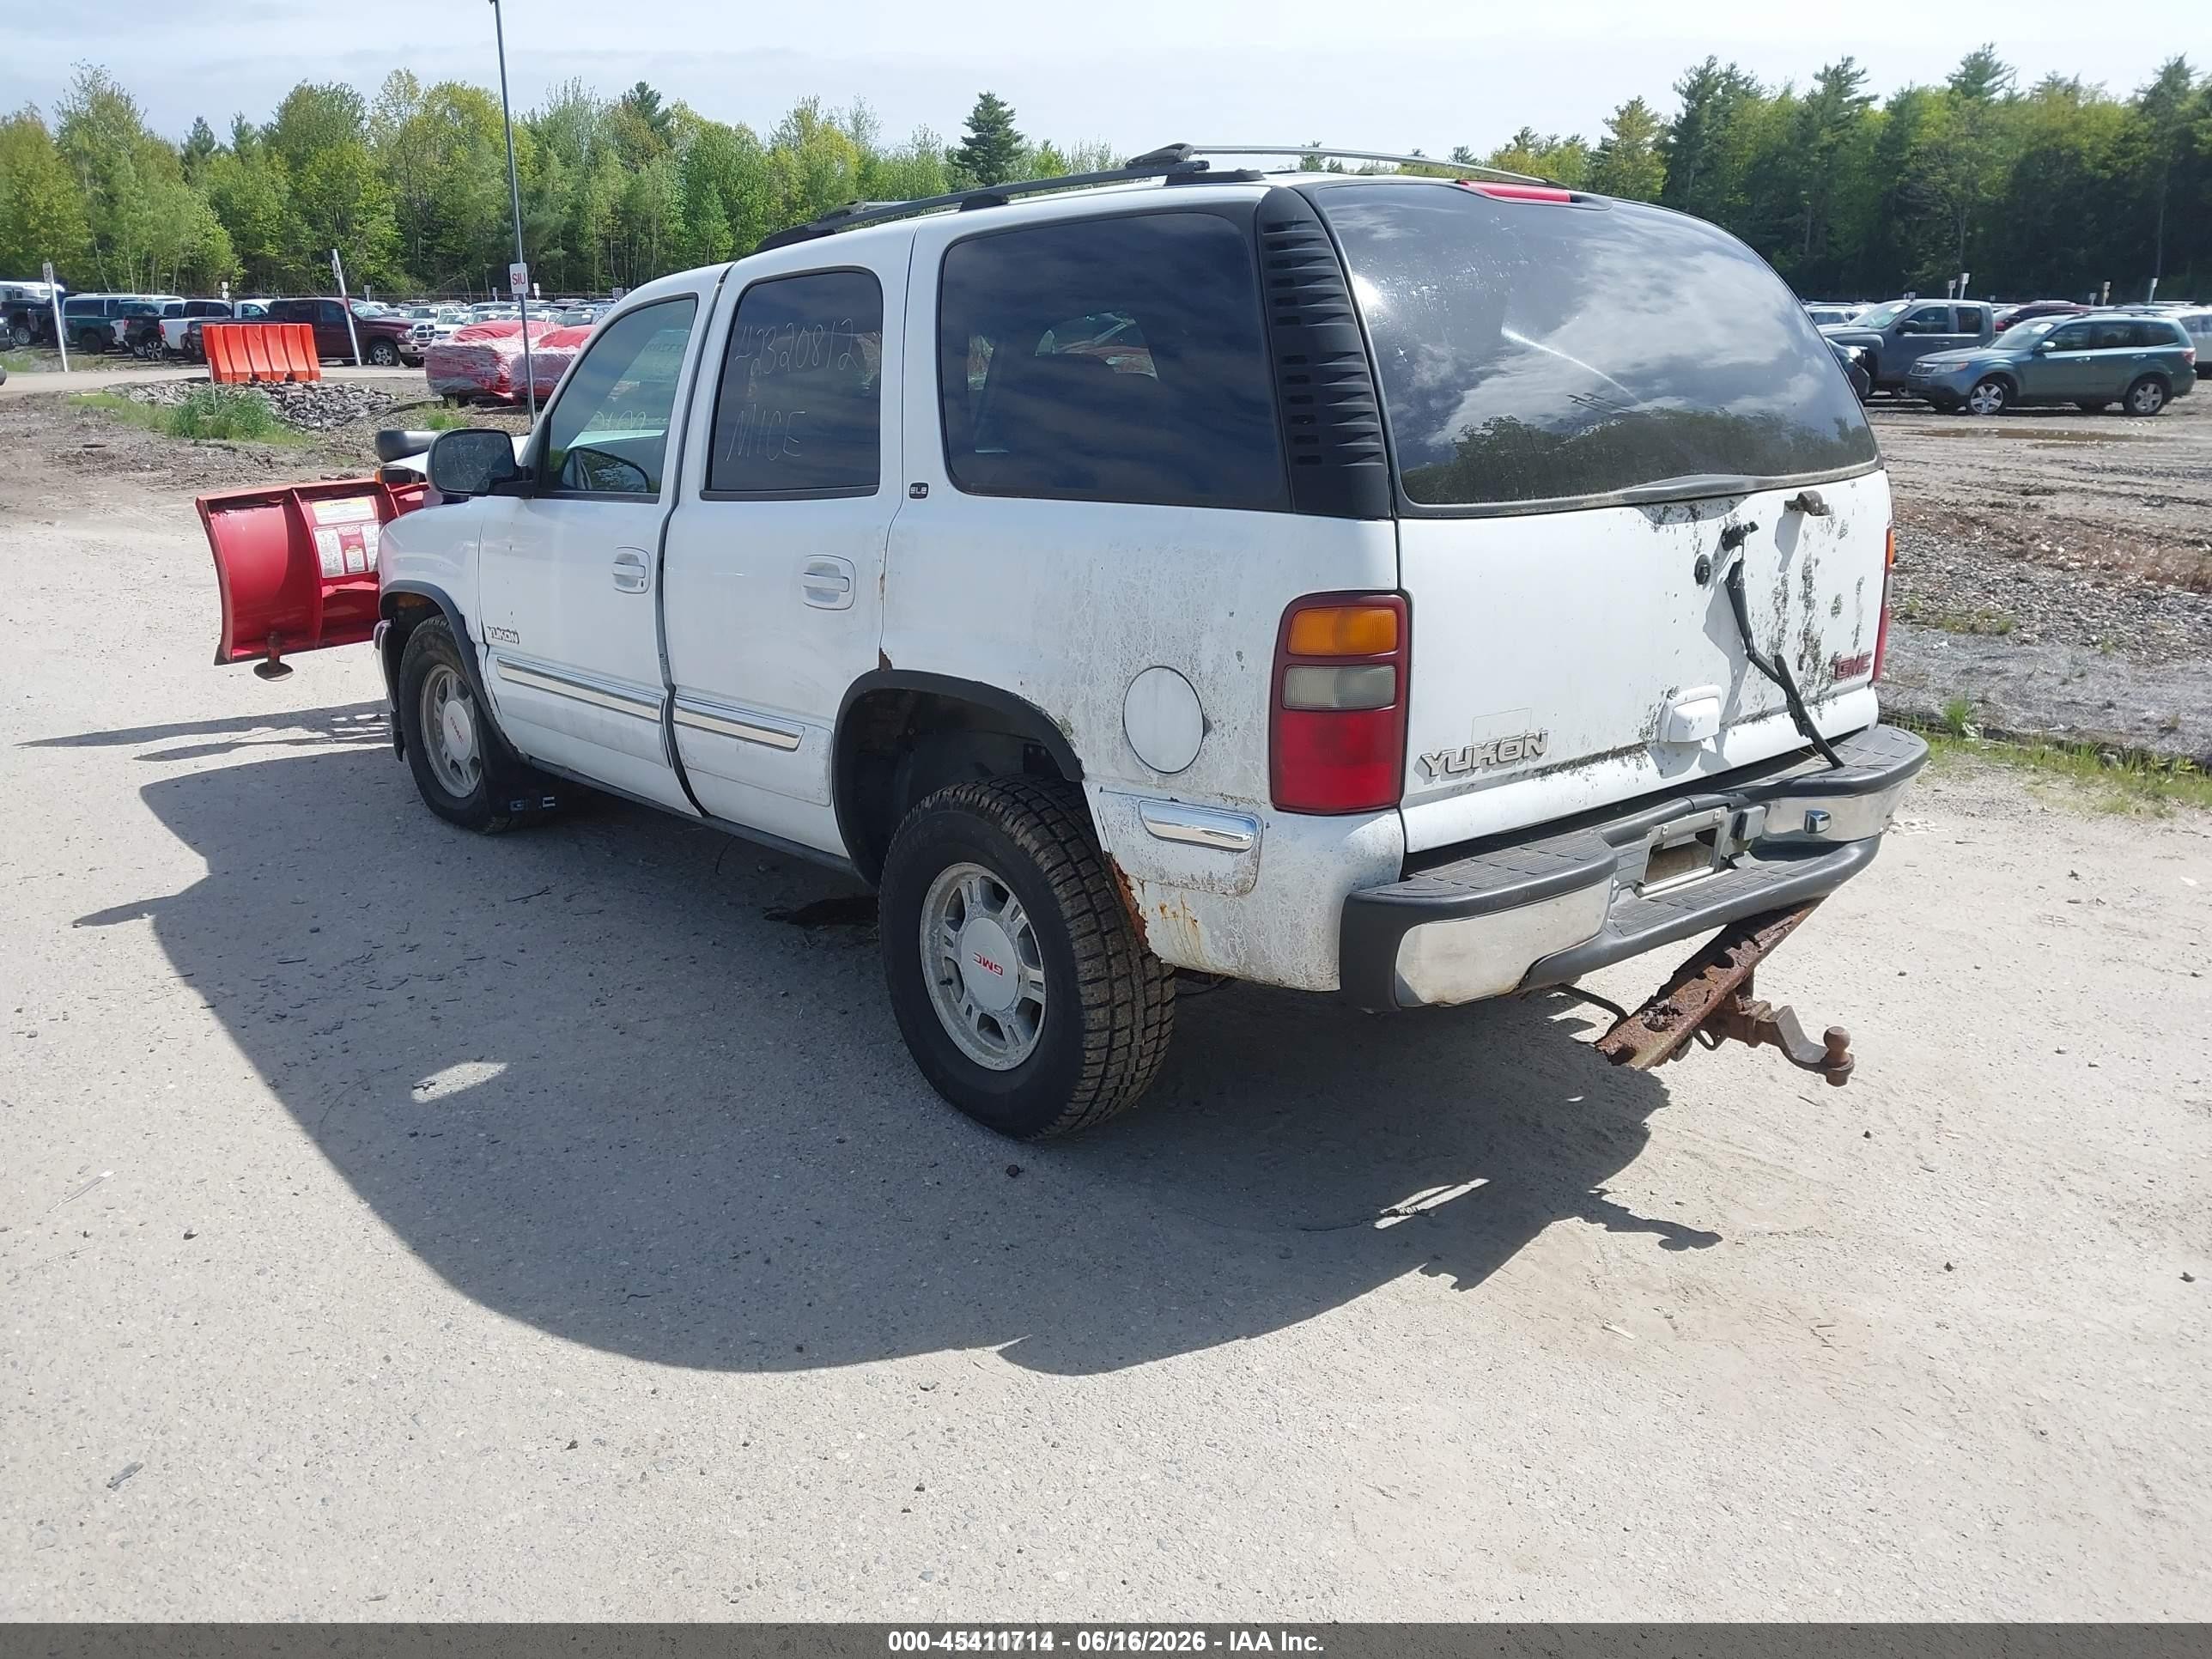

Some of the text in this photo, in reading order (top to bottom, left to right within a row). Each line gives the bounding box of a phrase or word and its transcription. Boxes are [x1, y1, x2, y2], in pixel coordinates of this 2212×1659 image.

[511, 272, 526, 286] SIU
[487, 626, 520, 645] YUKON
[1833, 651, 1873, 681] GMC
[1420, 731, 1549, 778] YUKON
[973, 951, 1004, 977] GMC
